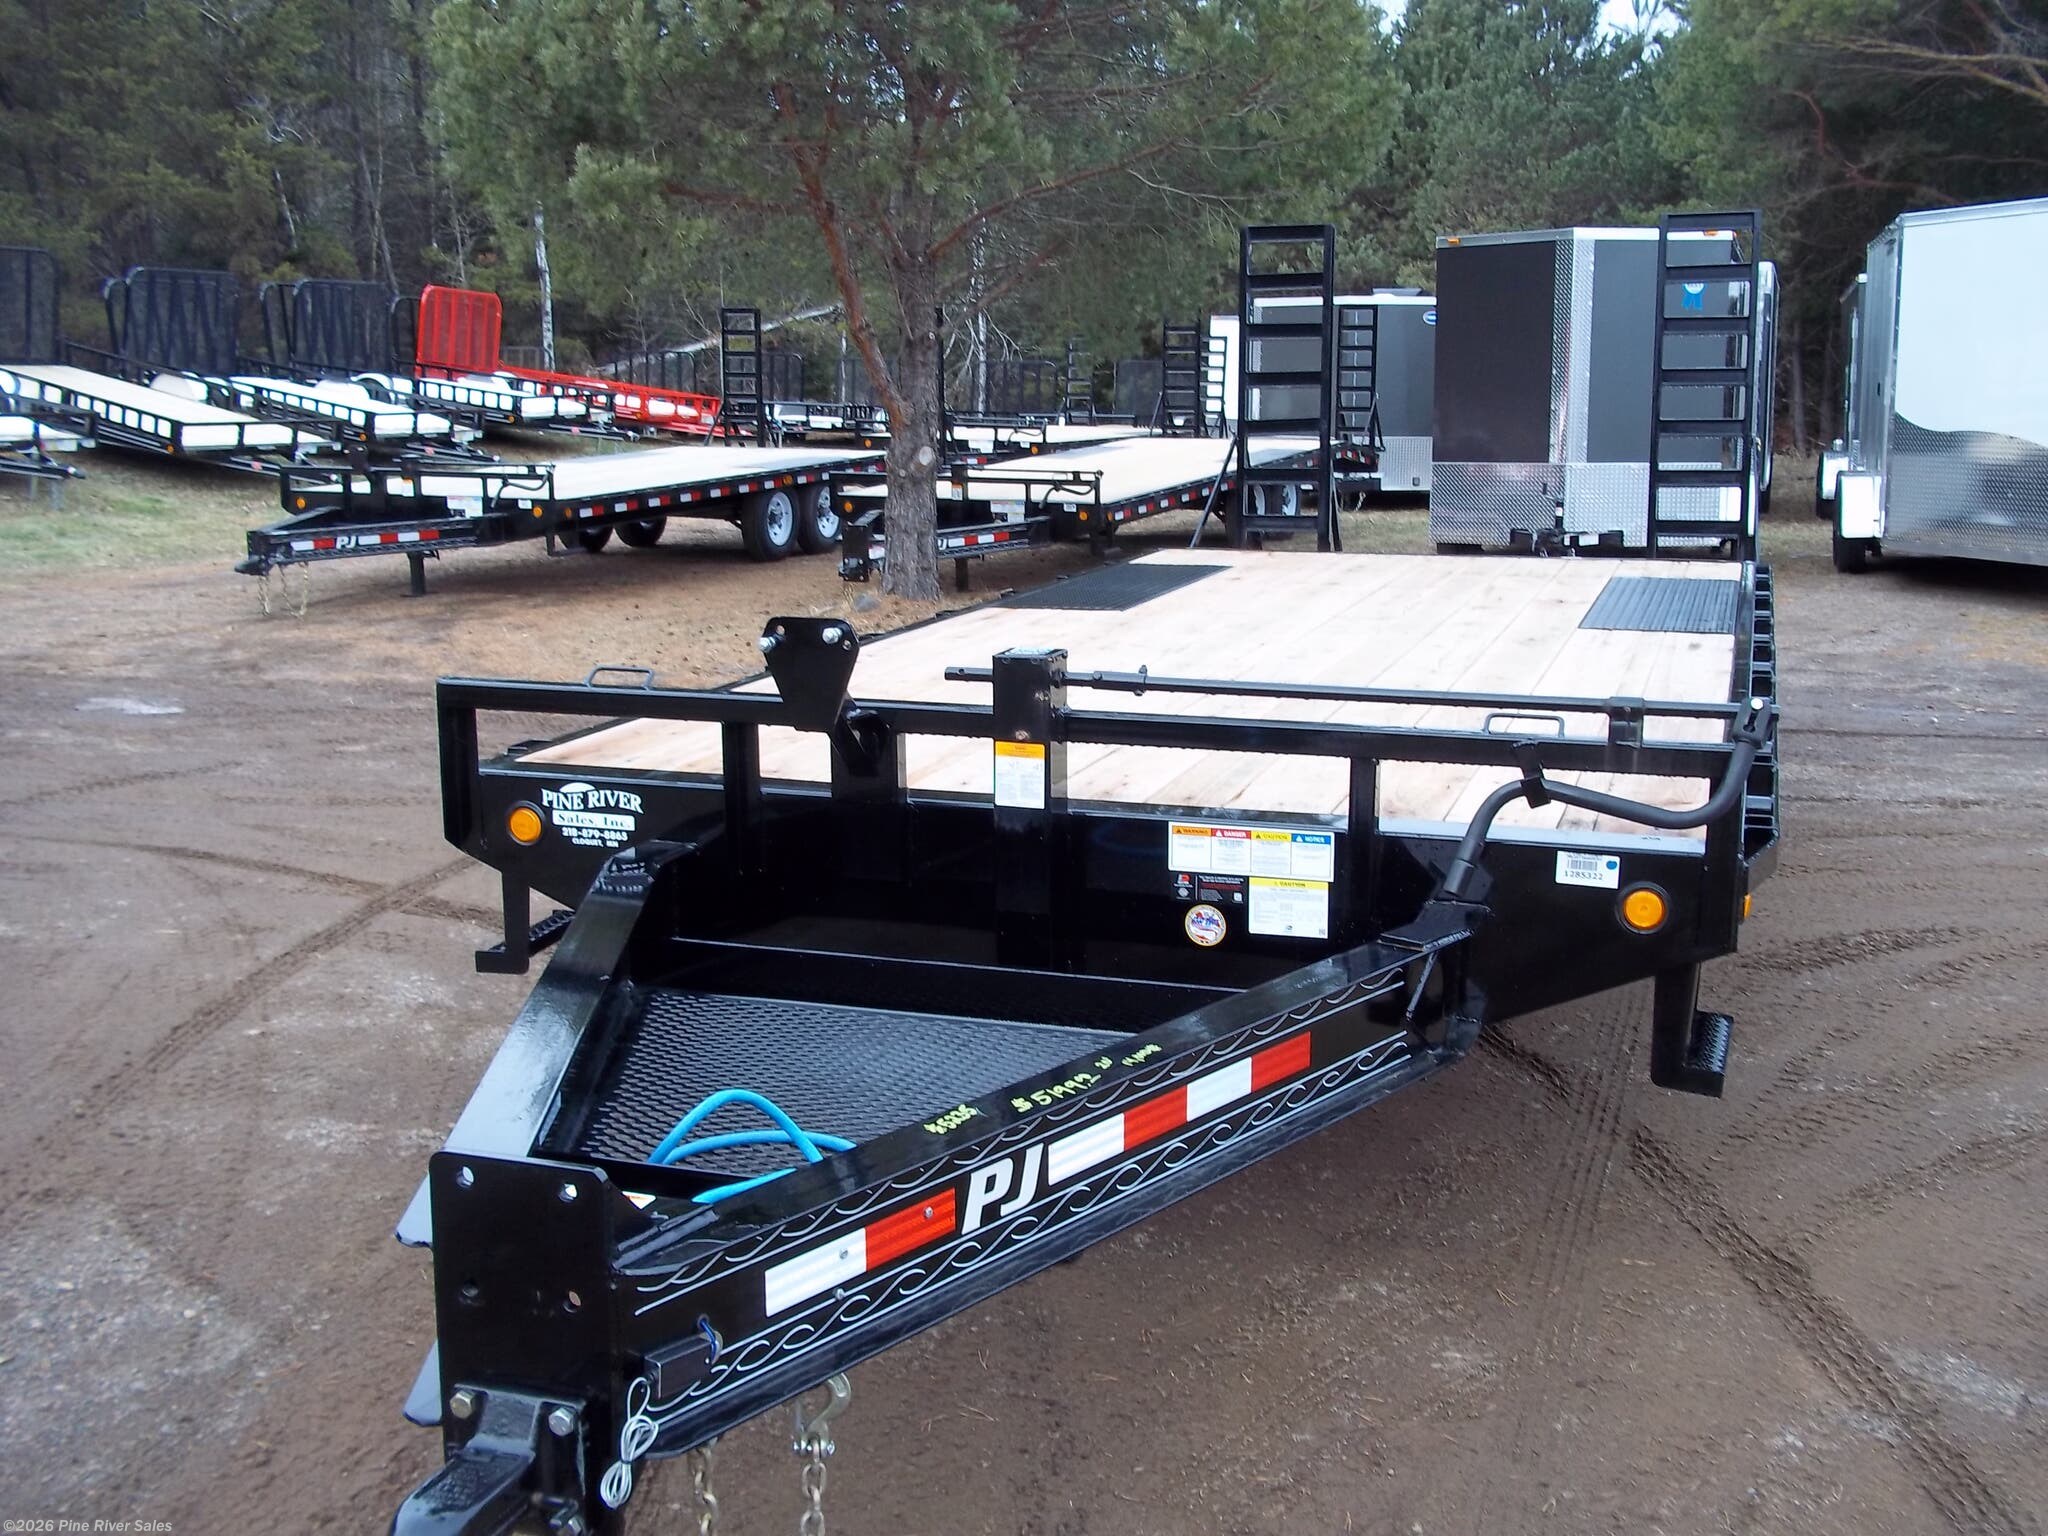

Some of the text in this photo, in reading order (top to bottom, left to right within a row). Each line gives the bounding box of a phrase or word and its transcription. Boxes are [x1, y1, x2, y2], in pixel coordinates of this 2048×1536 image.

[336, 535, 357, 549] PJ
[541, 788, 644, 815] PINE RIVER
[961, 1142, 1044, 1235] PJ
